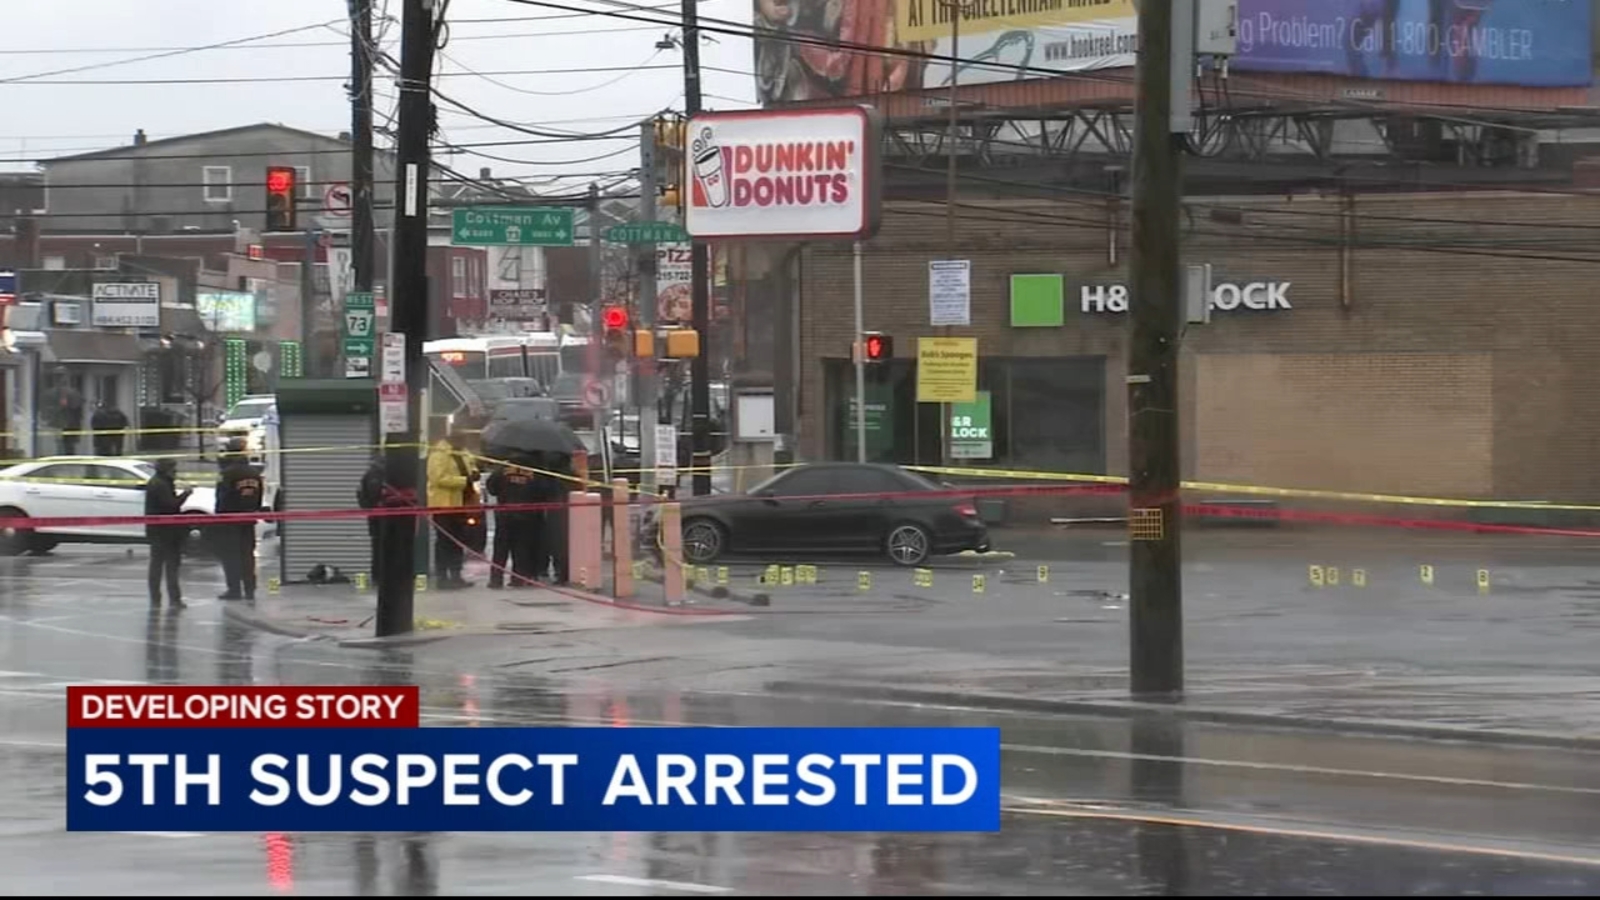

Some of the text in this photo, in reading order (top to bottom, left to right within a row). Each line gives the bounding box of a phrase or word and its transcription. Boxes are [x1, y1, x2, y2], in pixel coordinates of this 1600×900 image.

[1259, 12, 1345, 50] Problem?
[1349, 20, 1383, 52] Call
[1389, 22, 1533, 60] 1-800-GAMBLER
[735, 141, 854, 173] DUNKIN'
[734, 173, 848, 206] DONUTS
[465, 211, 561, 227] Cottman Av
[610, 229, 671, 241] COTTMAN
[1208, 281, 1293, 311] OCK
[349, 316, 367, 331] 73
